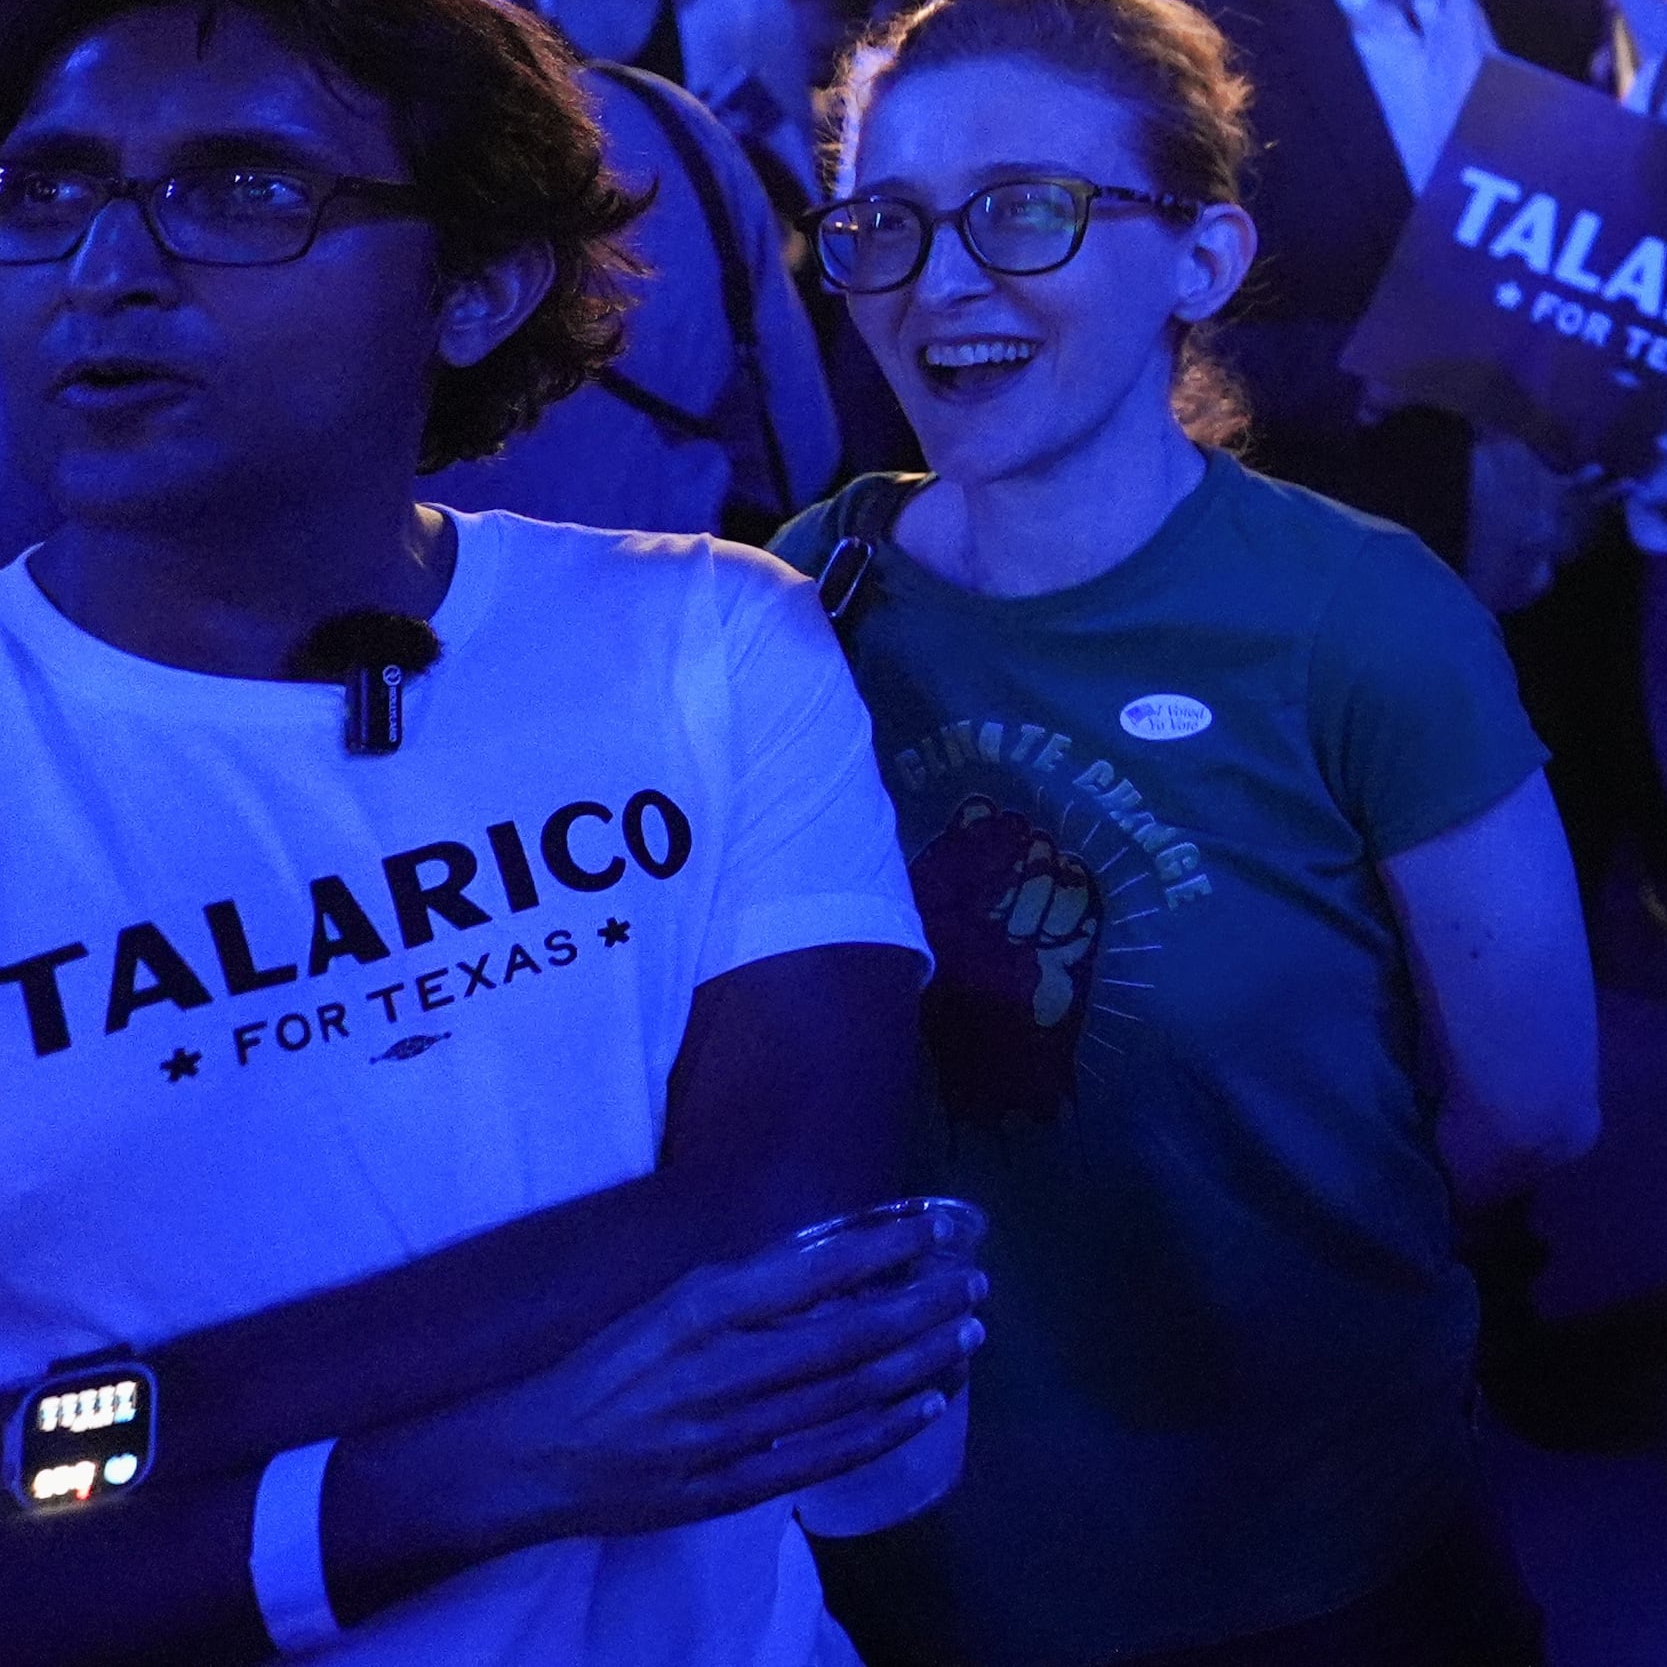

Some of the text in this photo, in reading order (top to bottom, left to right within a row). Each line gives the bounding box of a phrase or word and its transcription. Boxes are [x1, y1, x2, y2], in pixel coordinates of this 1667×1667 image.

[1531, 290, 1613, 347] FOR
[0, 789, 693, 1058] TALARICO
[232, 1002, 350, 1066] FOR
[366, 929, 578, 1025] TEXAS
